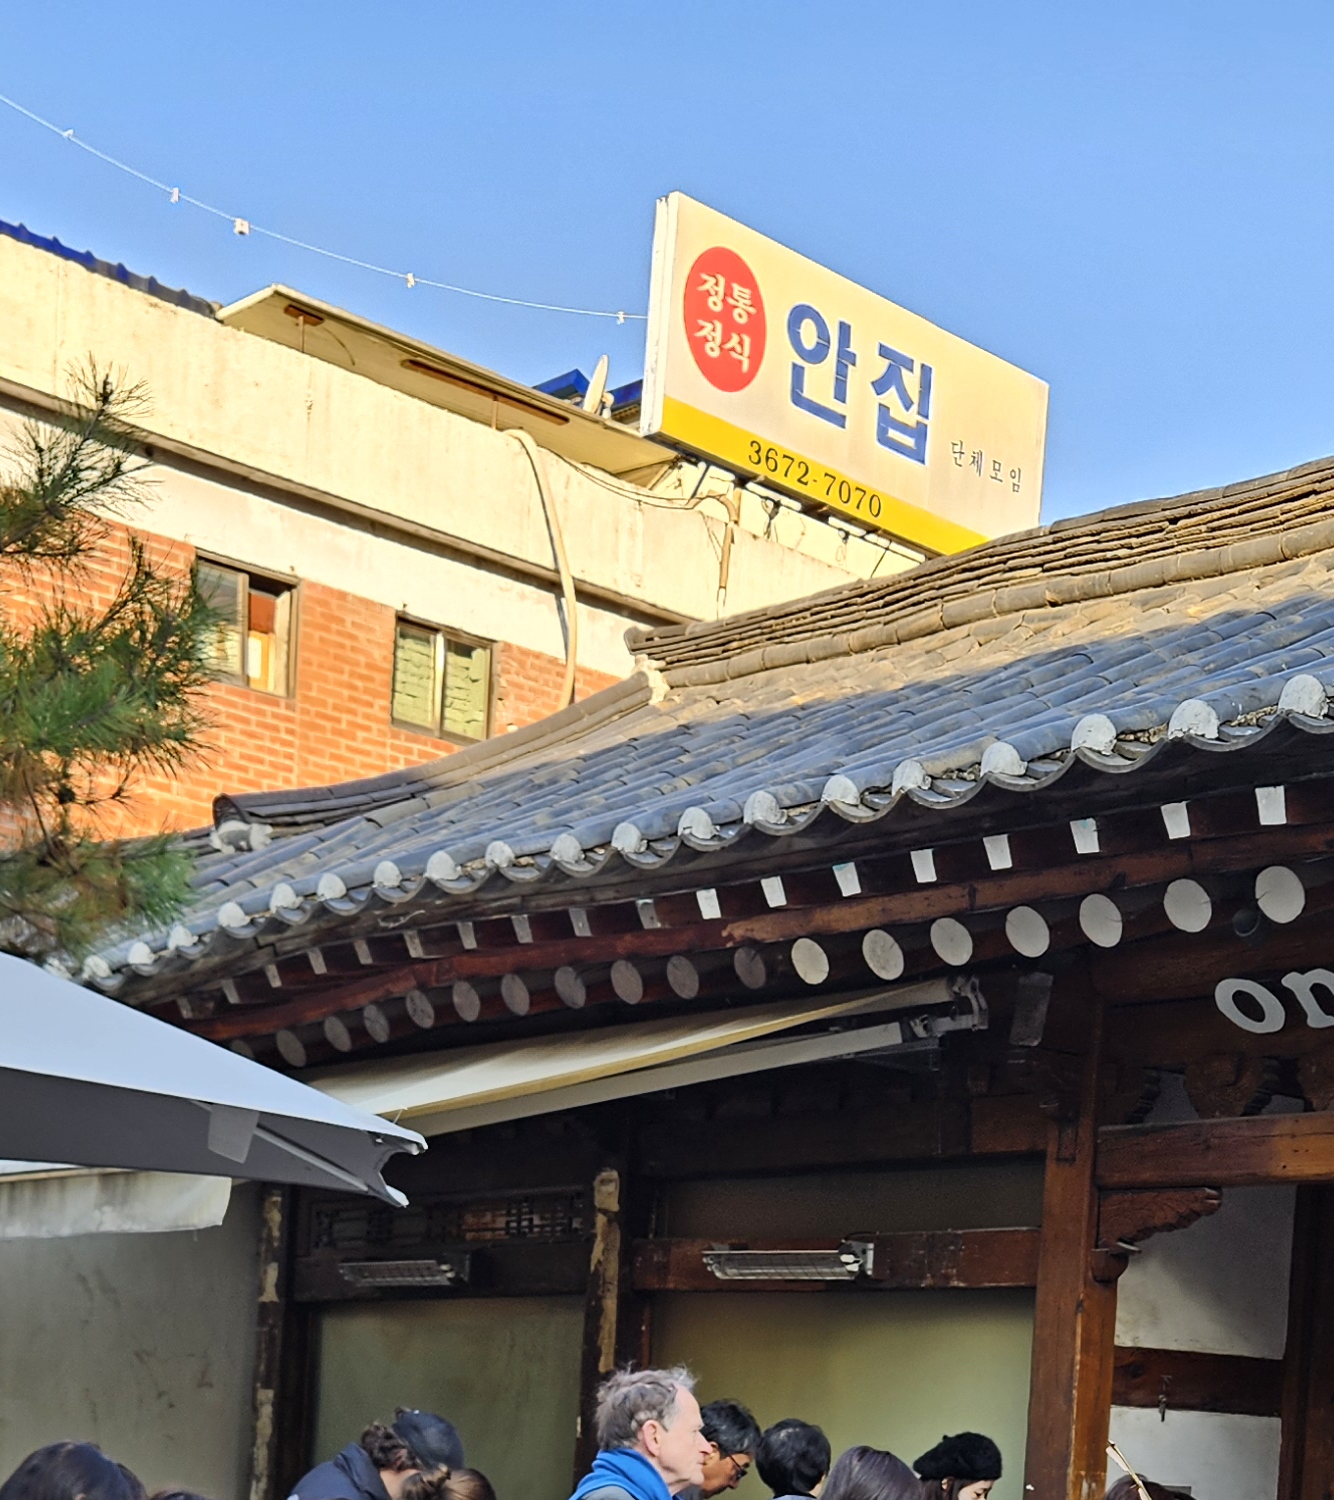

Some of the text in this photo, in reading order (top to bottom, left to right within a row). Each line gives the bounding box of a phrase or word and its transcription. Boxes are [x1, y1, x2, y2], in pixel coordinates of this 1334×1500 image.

[696, 272, 757, 325] 정통
[693, 318, 752, 374] 정식
[786, 301, 934, 467] 안집
[747, 439, 883, 520] 3672-7070
